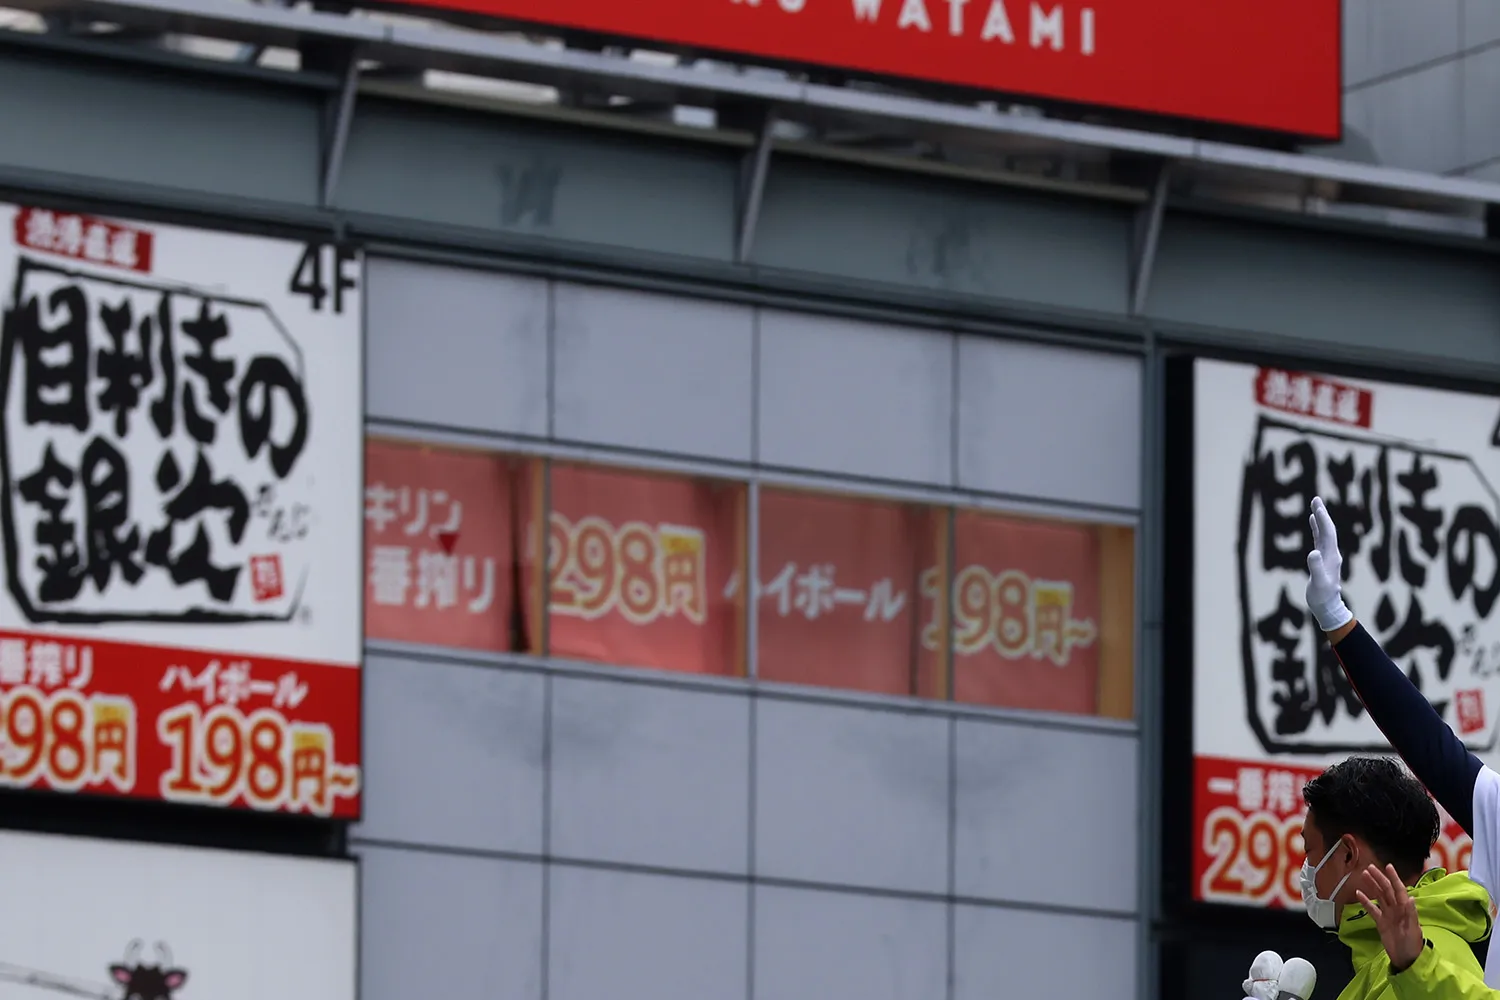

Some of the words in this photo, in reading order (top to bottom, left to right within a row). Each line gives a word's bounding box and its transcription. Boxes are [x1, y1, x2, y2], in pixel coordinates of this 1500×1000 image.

[290, 241, 358, 315] 4F
[20, 284, 310, 479] 目利きの
[17, 438, 250, 604] 銀次
[158, 660, 309, 707] ハイボール
[0, 686, 137, 793] 98円
[1207, 766, 1306, 813] 一番搾
